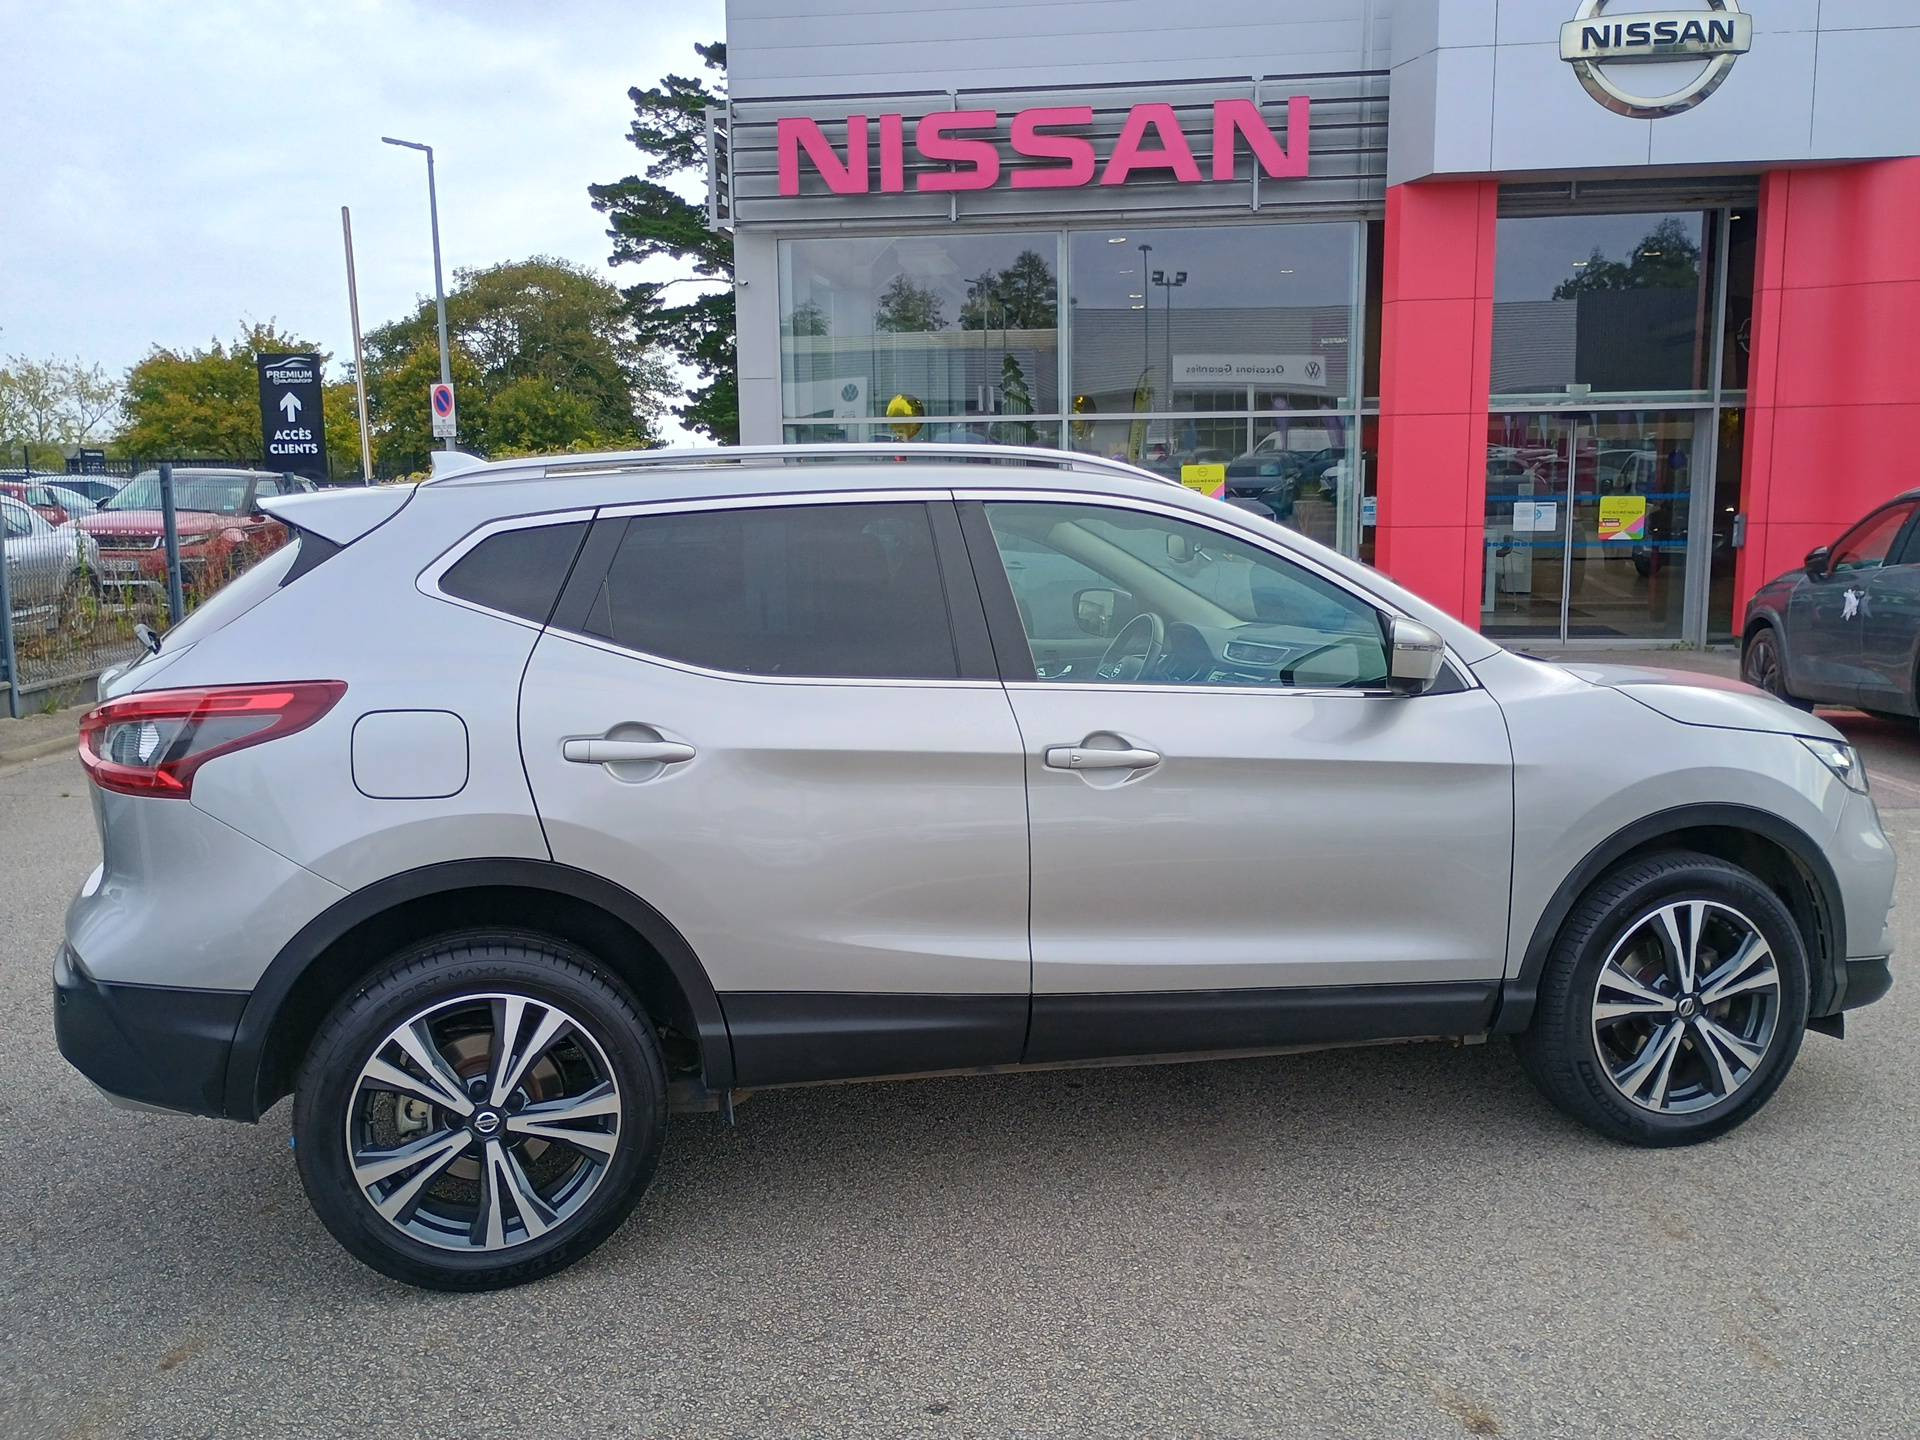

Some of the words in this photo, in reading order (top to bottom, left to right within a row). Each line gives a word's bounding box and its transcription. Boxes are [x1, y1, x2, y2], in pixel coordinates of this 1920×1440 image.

[1582, 19, 1735, 50] NISSAN
[777, 95, 1310, 197] NISSAN
[266, 370, 313, 379] PREMIUM
[274, 427, 312, 440] ACCÈS
[269, 443, 318, 454] CLIENTS
